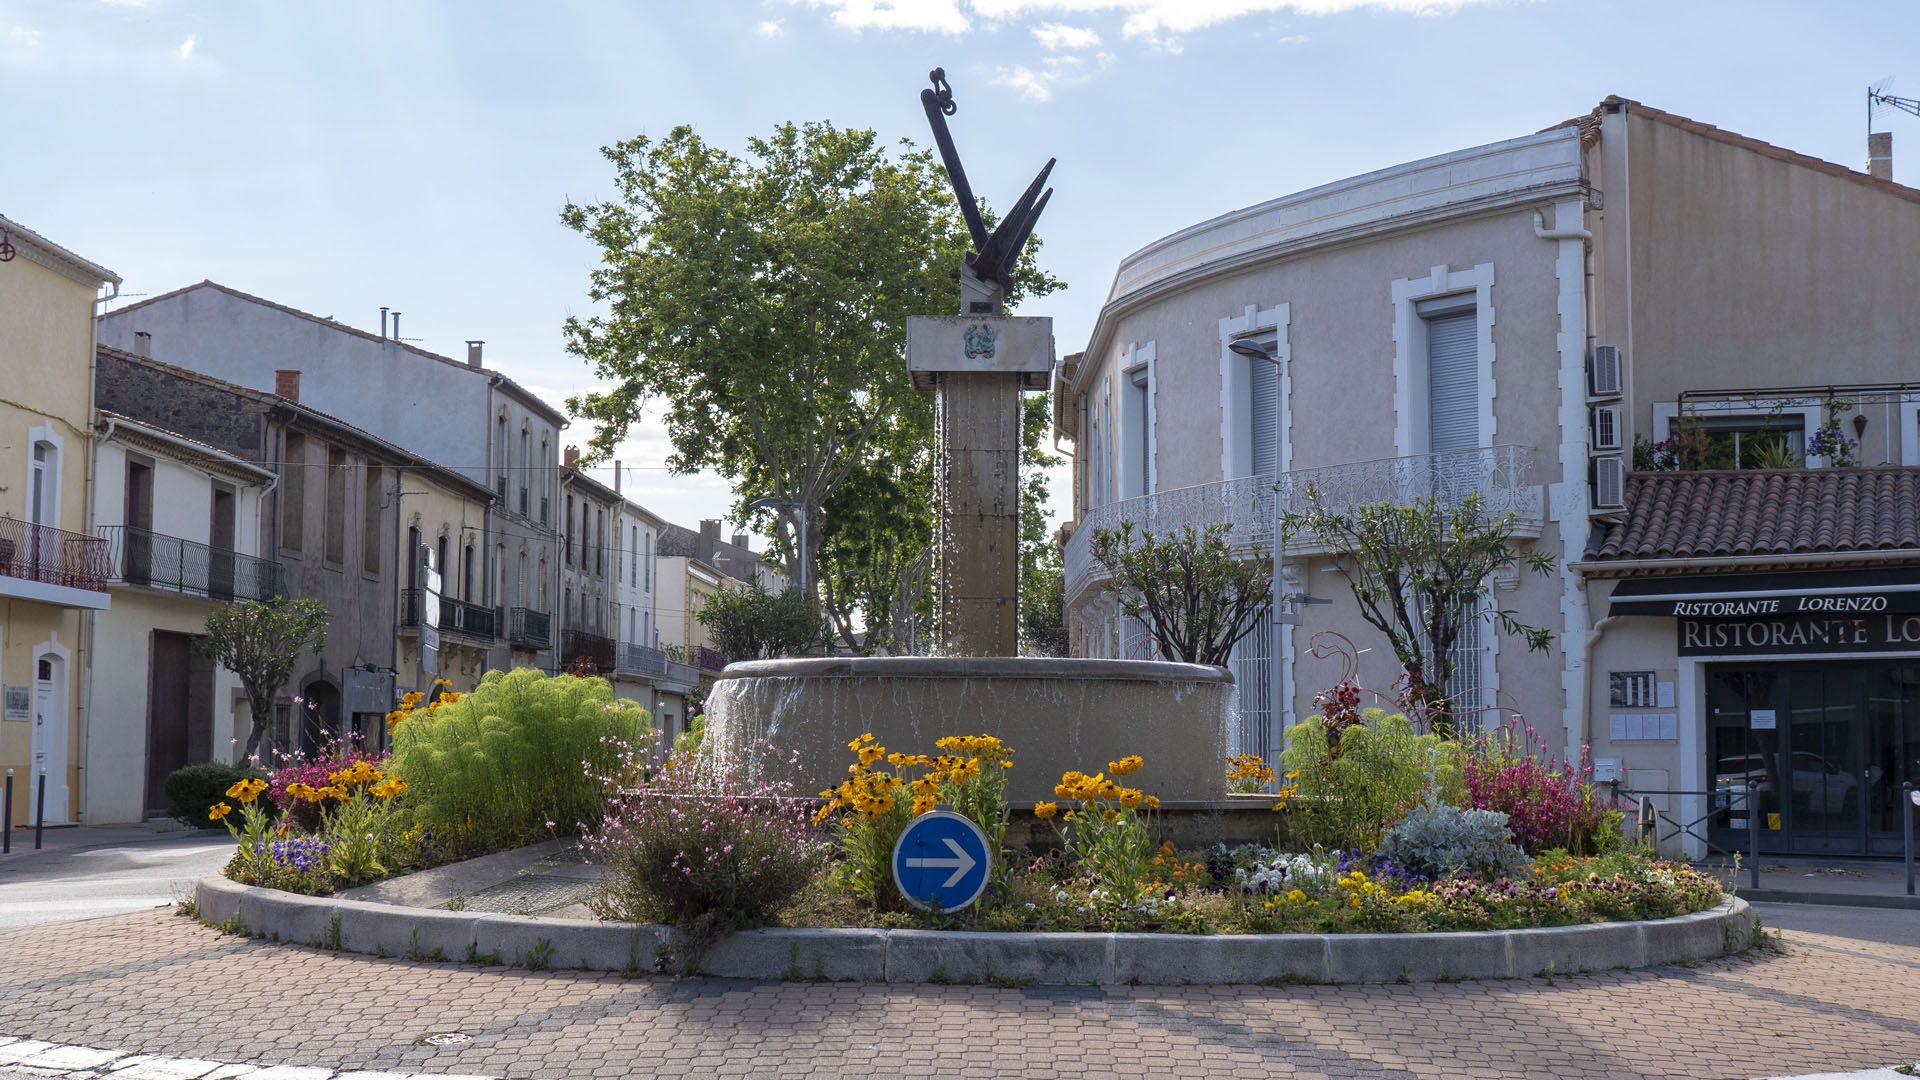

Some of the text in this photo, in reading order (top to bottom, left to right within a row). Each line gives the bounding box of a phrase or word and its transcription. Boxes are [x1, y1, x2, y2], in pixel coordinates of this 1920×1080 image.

[1672, 596, 1888, 616] RISTORANTE LORENZO
[1682, 619, 1868, 648] RISTORANTE
